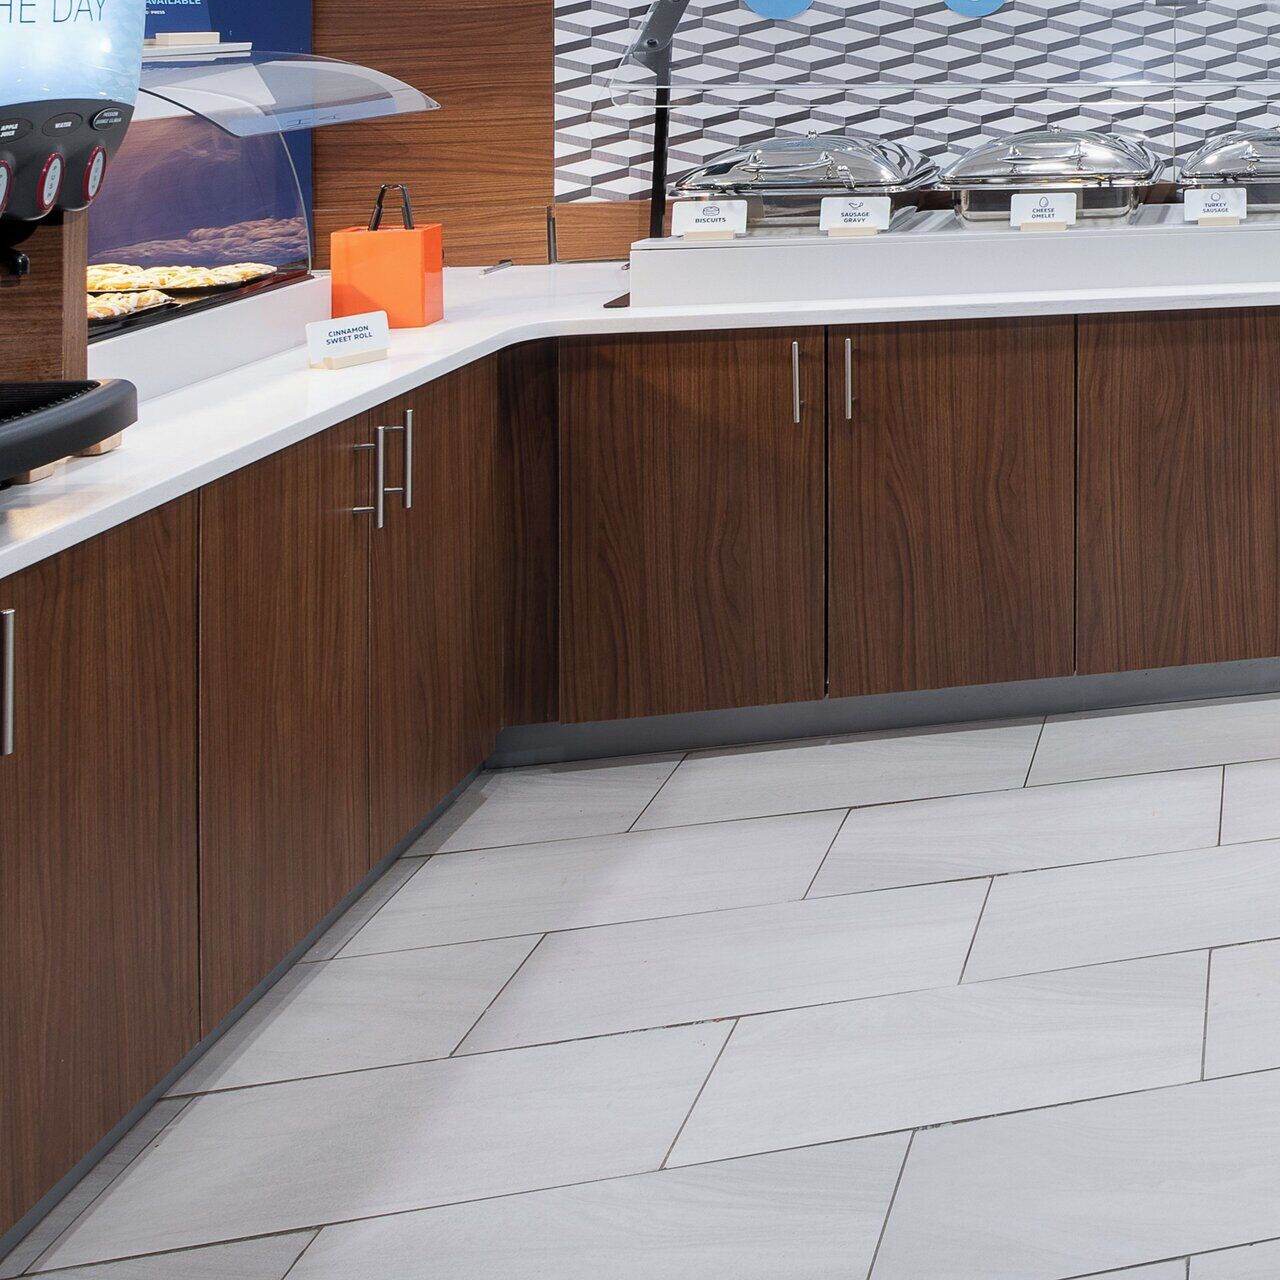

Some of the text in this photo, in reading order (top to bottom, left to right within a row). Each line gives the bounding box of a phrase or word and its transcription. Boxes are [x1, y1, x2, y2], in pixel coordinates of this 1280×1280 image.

[1, 123, 19, 131] APPLE
[328, 325, 369, 337] CINNAMON
[326, 332, 373, 345] SWEET ROLL
